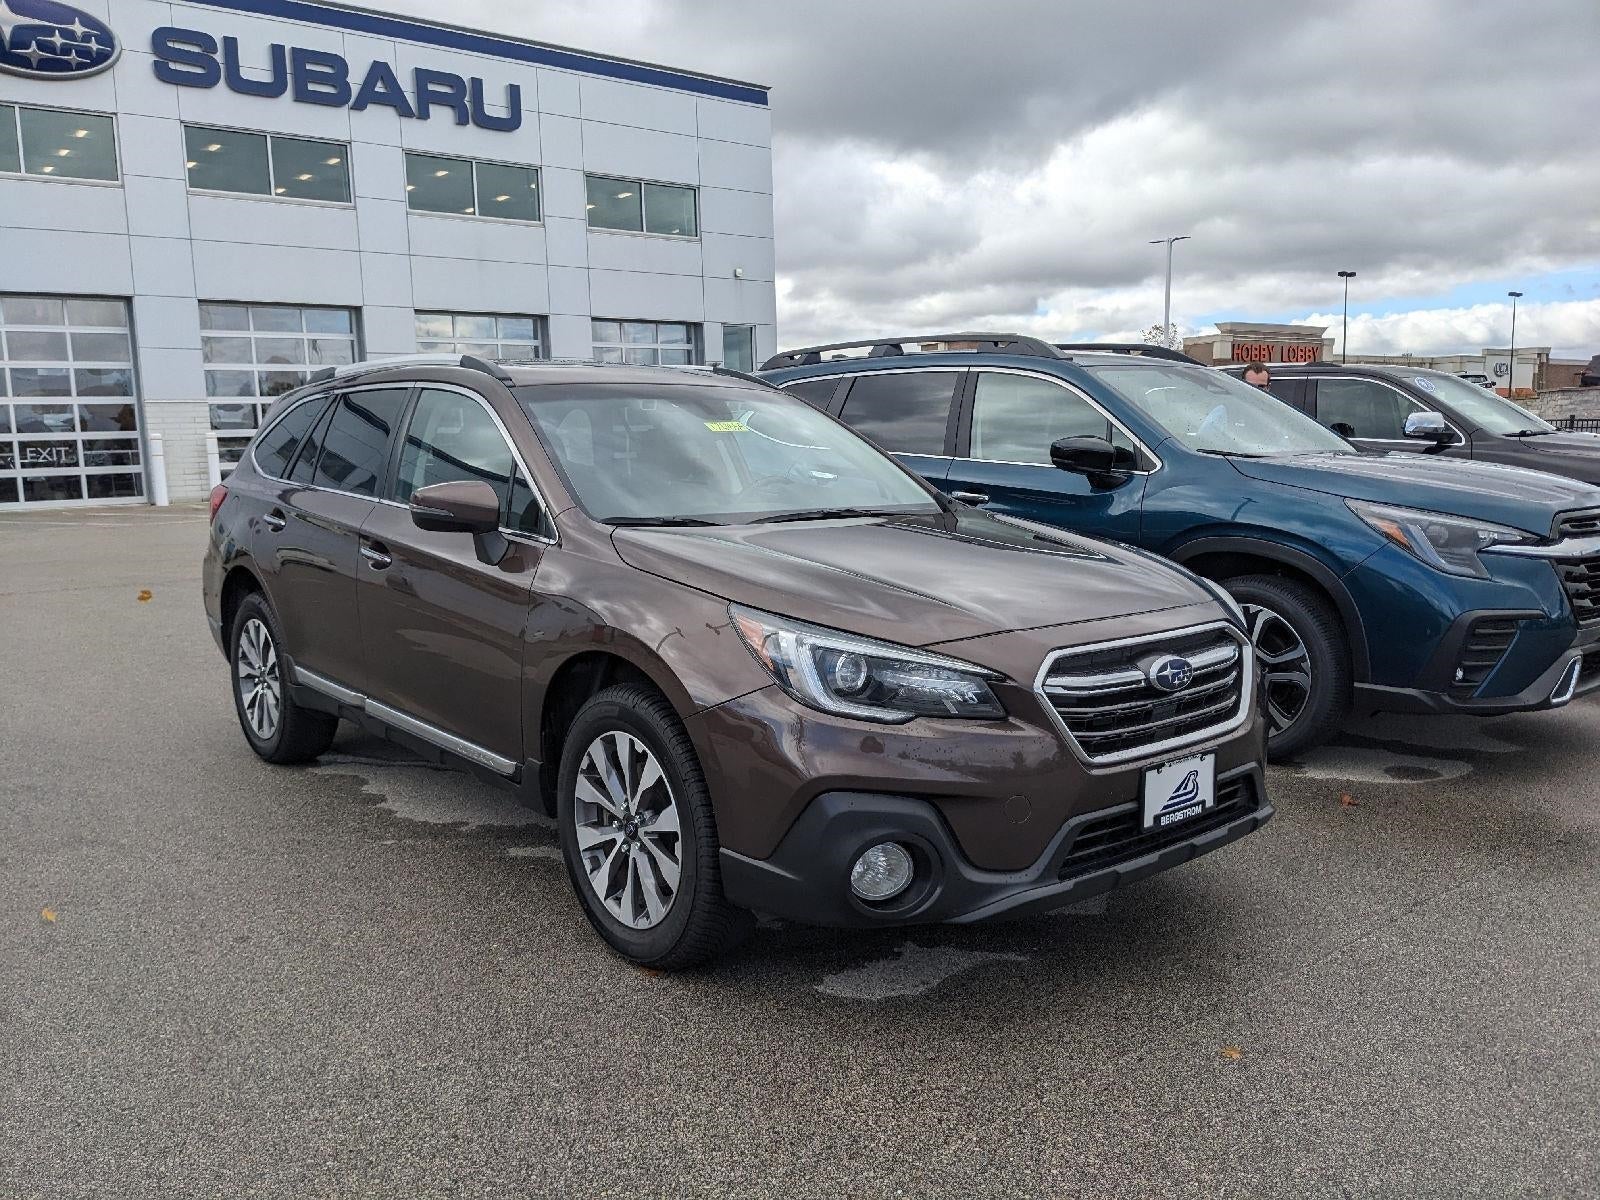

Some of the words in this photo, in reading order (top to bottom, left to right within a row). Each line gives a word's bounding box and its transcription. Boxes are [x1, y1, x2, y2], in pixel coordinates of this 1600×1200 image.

[151, 26, 522, 132] SUBARU
[1232, 343, 1275, 362] HOBBY
[1281, 345, 1319, 363] LOBBY
[26, 447, 69, 462] EXIT
[1160, 804, 1202, 826] BERGSTROM
